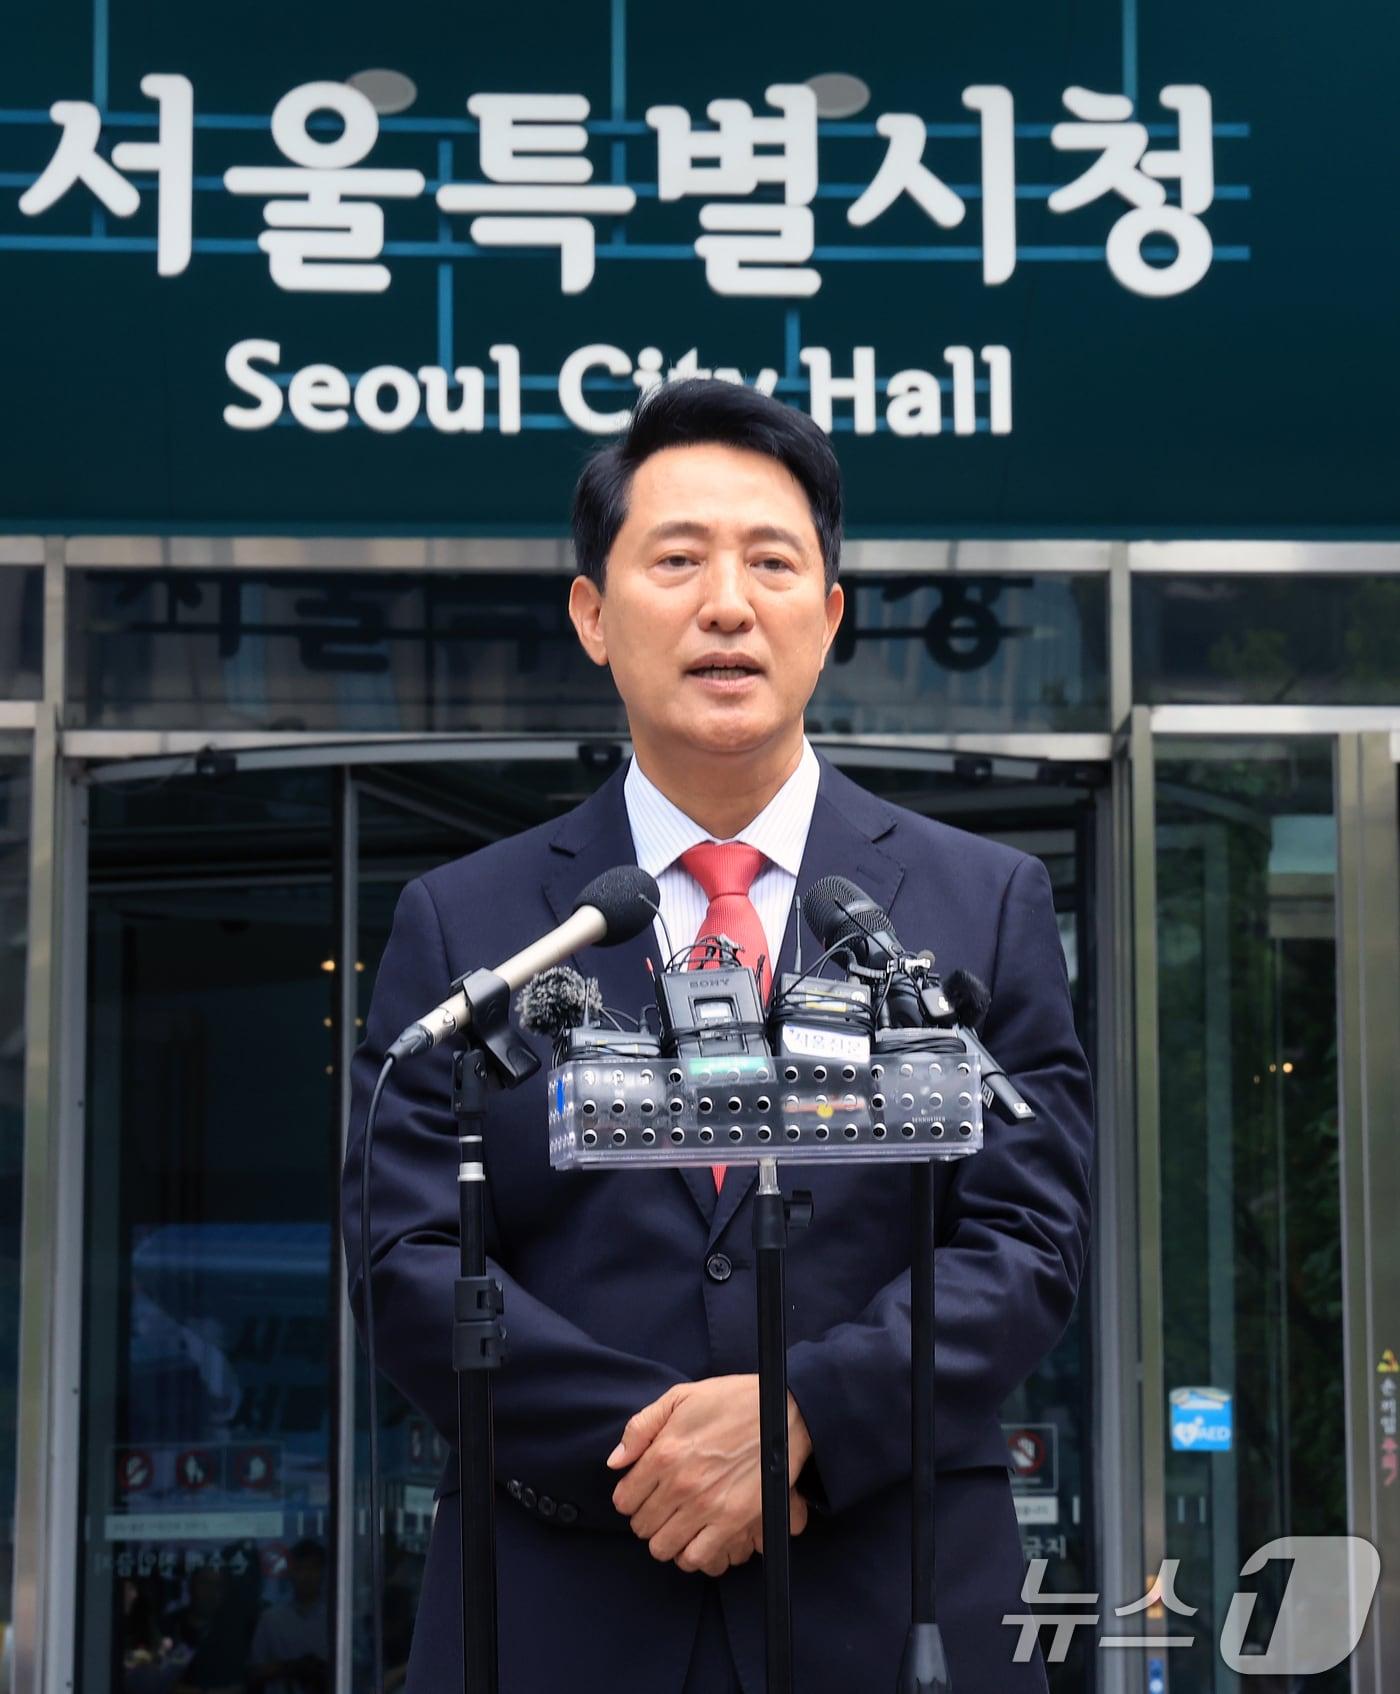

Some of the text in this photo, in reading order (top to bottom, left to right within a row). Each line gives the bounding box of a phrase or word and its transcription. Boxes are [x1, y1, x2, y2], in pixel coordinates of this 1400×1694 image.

[19, 73, 1214, 297] 서울특별시청
[223, 338, 521, 434] Seoul
[800, 345, 1012, 435] Hall
[689, 978, 730, 989] SONY
